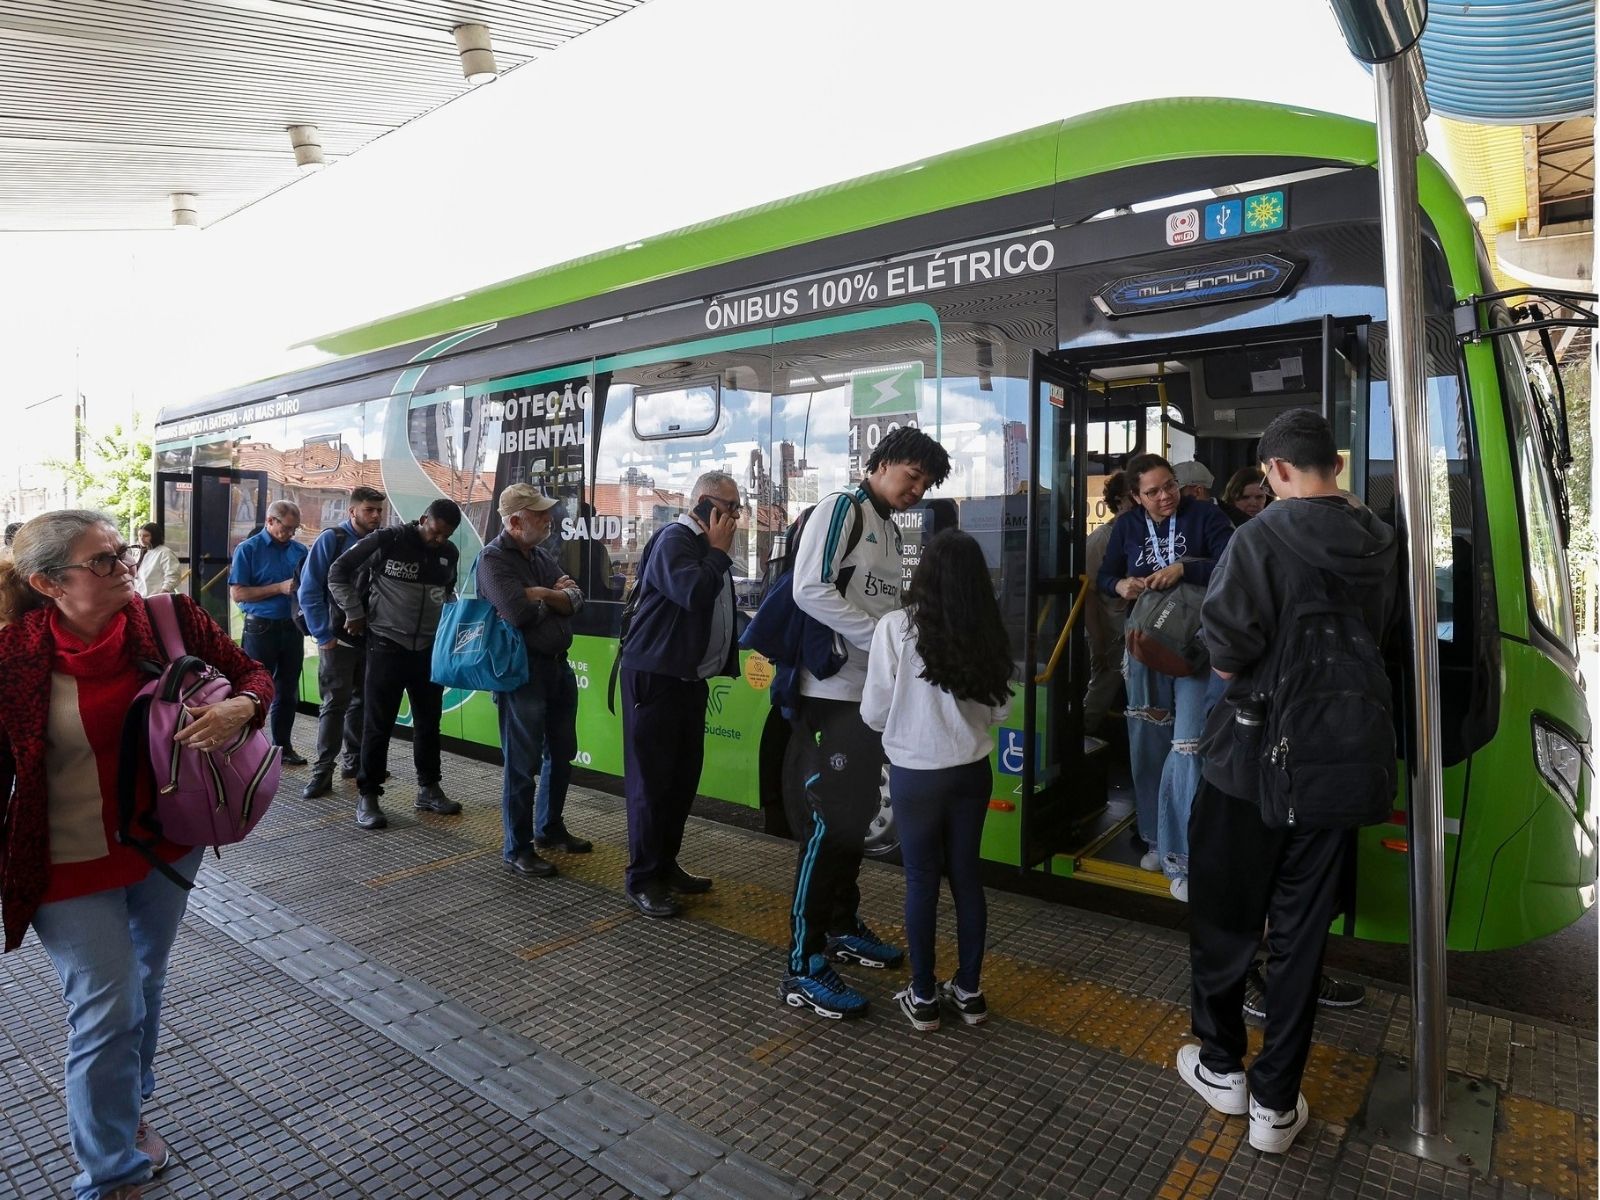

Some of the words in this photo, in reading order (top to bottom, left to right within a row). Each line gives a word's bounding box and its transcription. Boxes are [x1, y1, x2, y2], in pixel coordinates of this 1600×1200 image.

[704, 288, 799, 331] ÔNIBUS
[808, 270, 878, 310] 100%
[887, 239, 1055, 297] ELÉTRICO
[243, 409, 254, 422] AR
[255, 404, 275, 420] MAIS
[276, 399, 300, 416] PURO
[384, 568, 418, 580] FUNCTION
[577, 661, 588, 672] DE
[704, 721, 741, 740] Sudeste
[1256, 1111, 1272, 1122] NIKE
